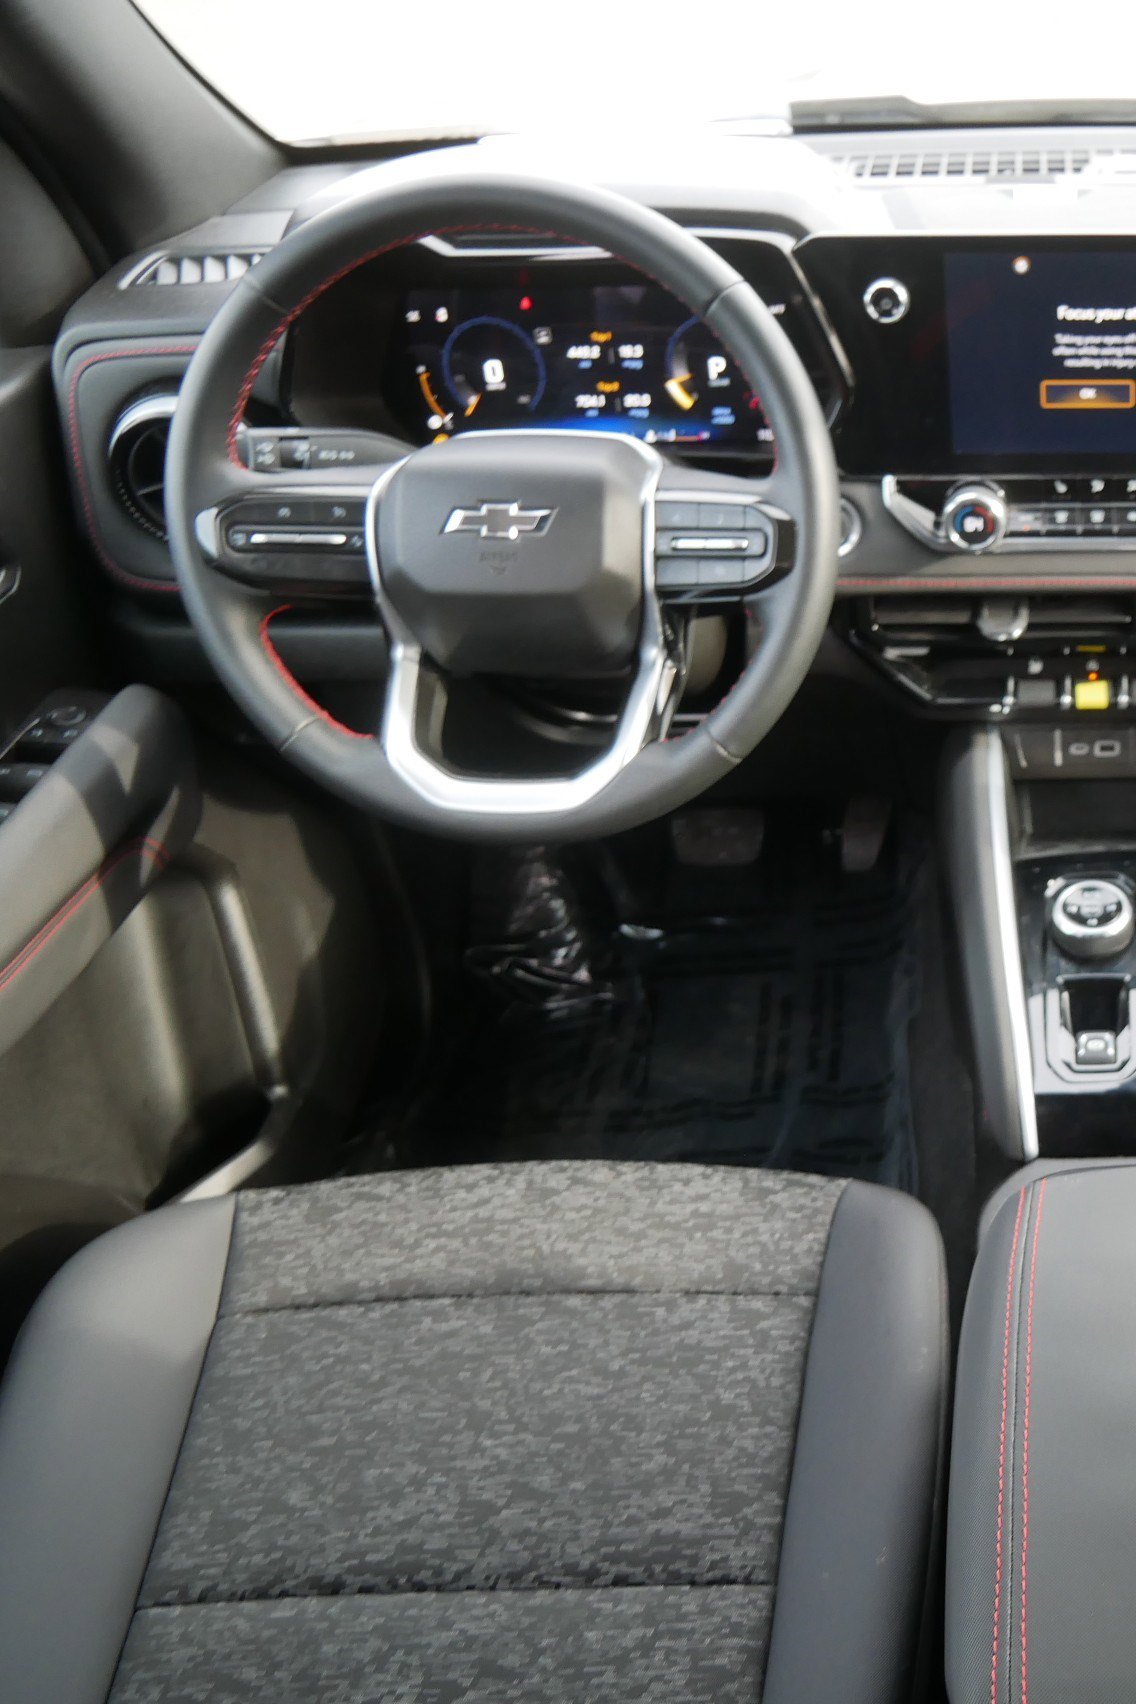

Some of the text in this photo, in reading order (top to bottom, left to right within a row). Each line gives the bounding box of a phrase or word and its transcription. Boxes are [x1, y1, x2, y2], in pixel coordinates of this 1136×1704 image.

[1057, 305, 1095, 320] Focus
[1095, 308, 1124, 323] your
[483, 358, 504, 384] 0
[707, 356, 727, 380] P
